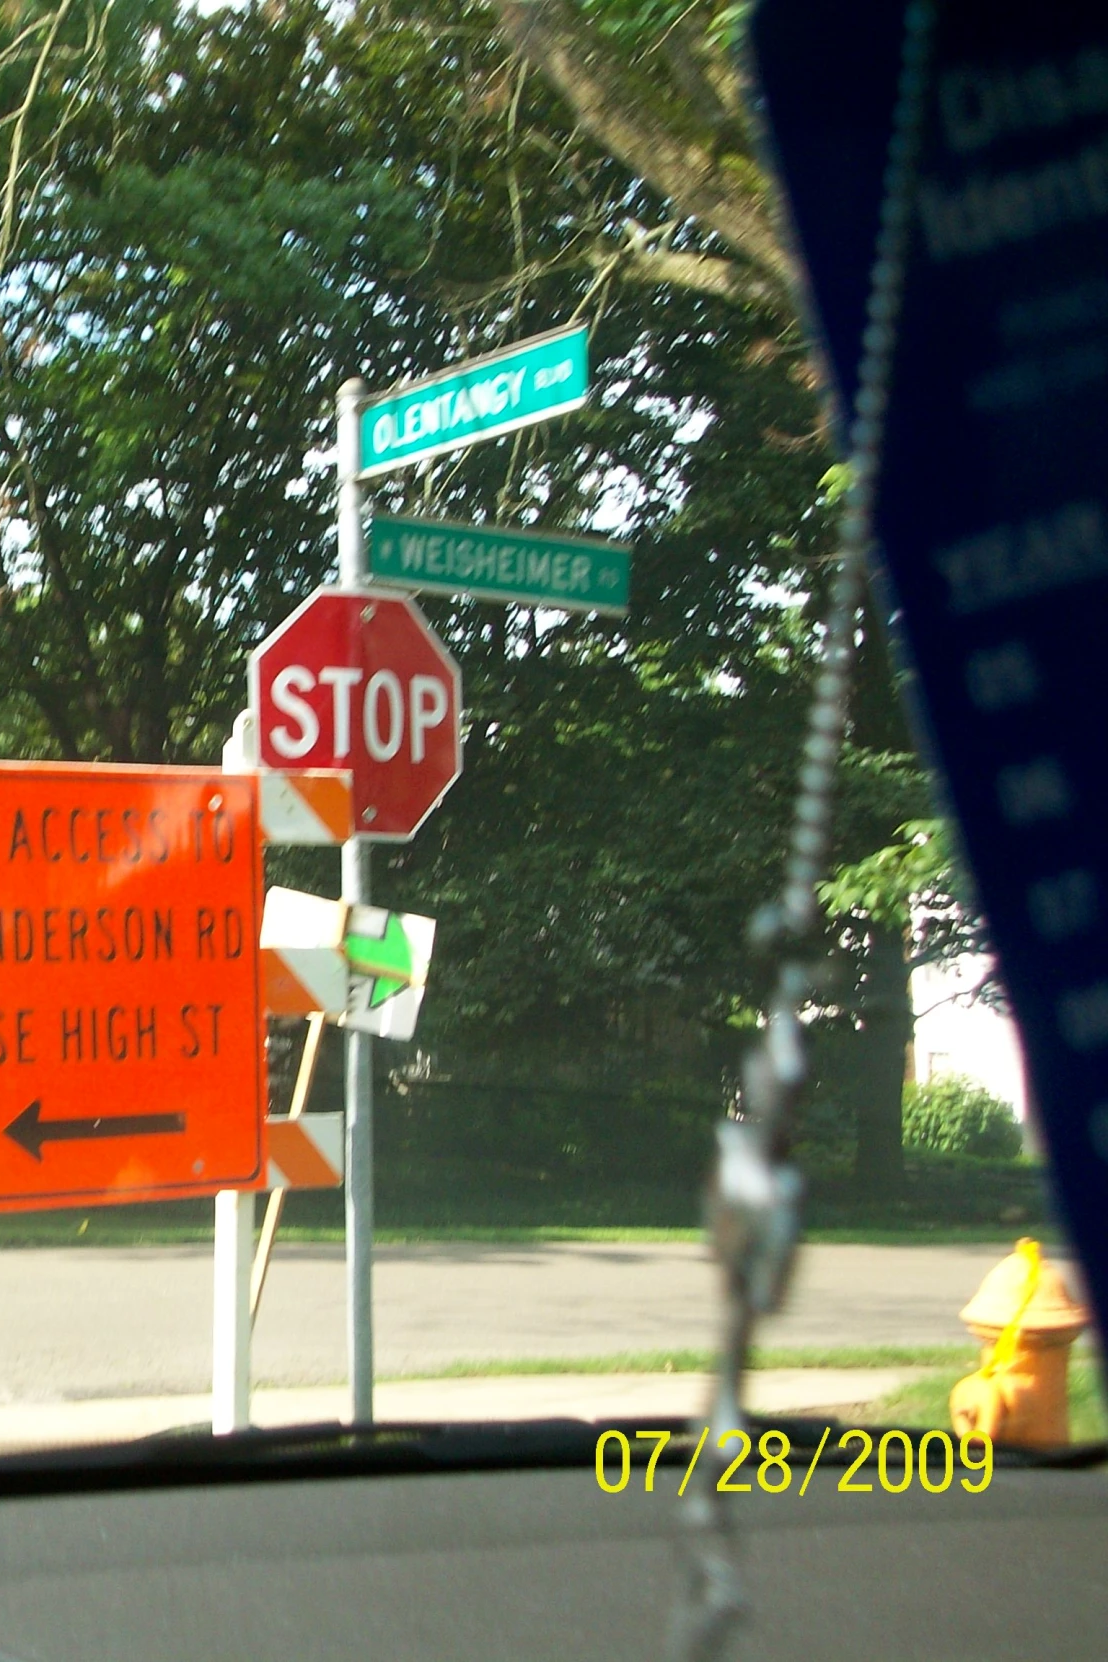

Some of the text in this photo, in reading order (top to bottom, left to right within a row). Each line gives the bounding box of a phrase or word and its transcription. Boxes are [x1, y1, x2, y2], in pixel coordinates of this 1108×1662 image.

[373, 366, 527, 454] OLENTANGY
[399, 532, 592, 593] WEISHEIMER
[269, 664, 449, 765] STOP
[9, 807, 171, 864] ACCESS
[190, 808, 235, 864] TO
[196, 908, 243, 962] RD
[60, 1005, 157, 1063] HIGH
[179, 1004, 223, 1058] ST
